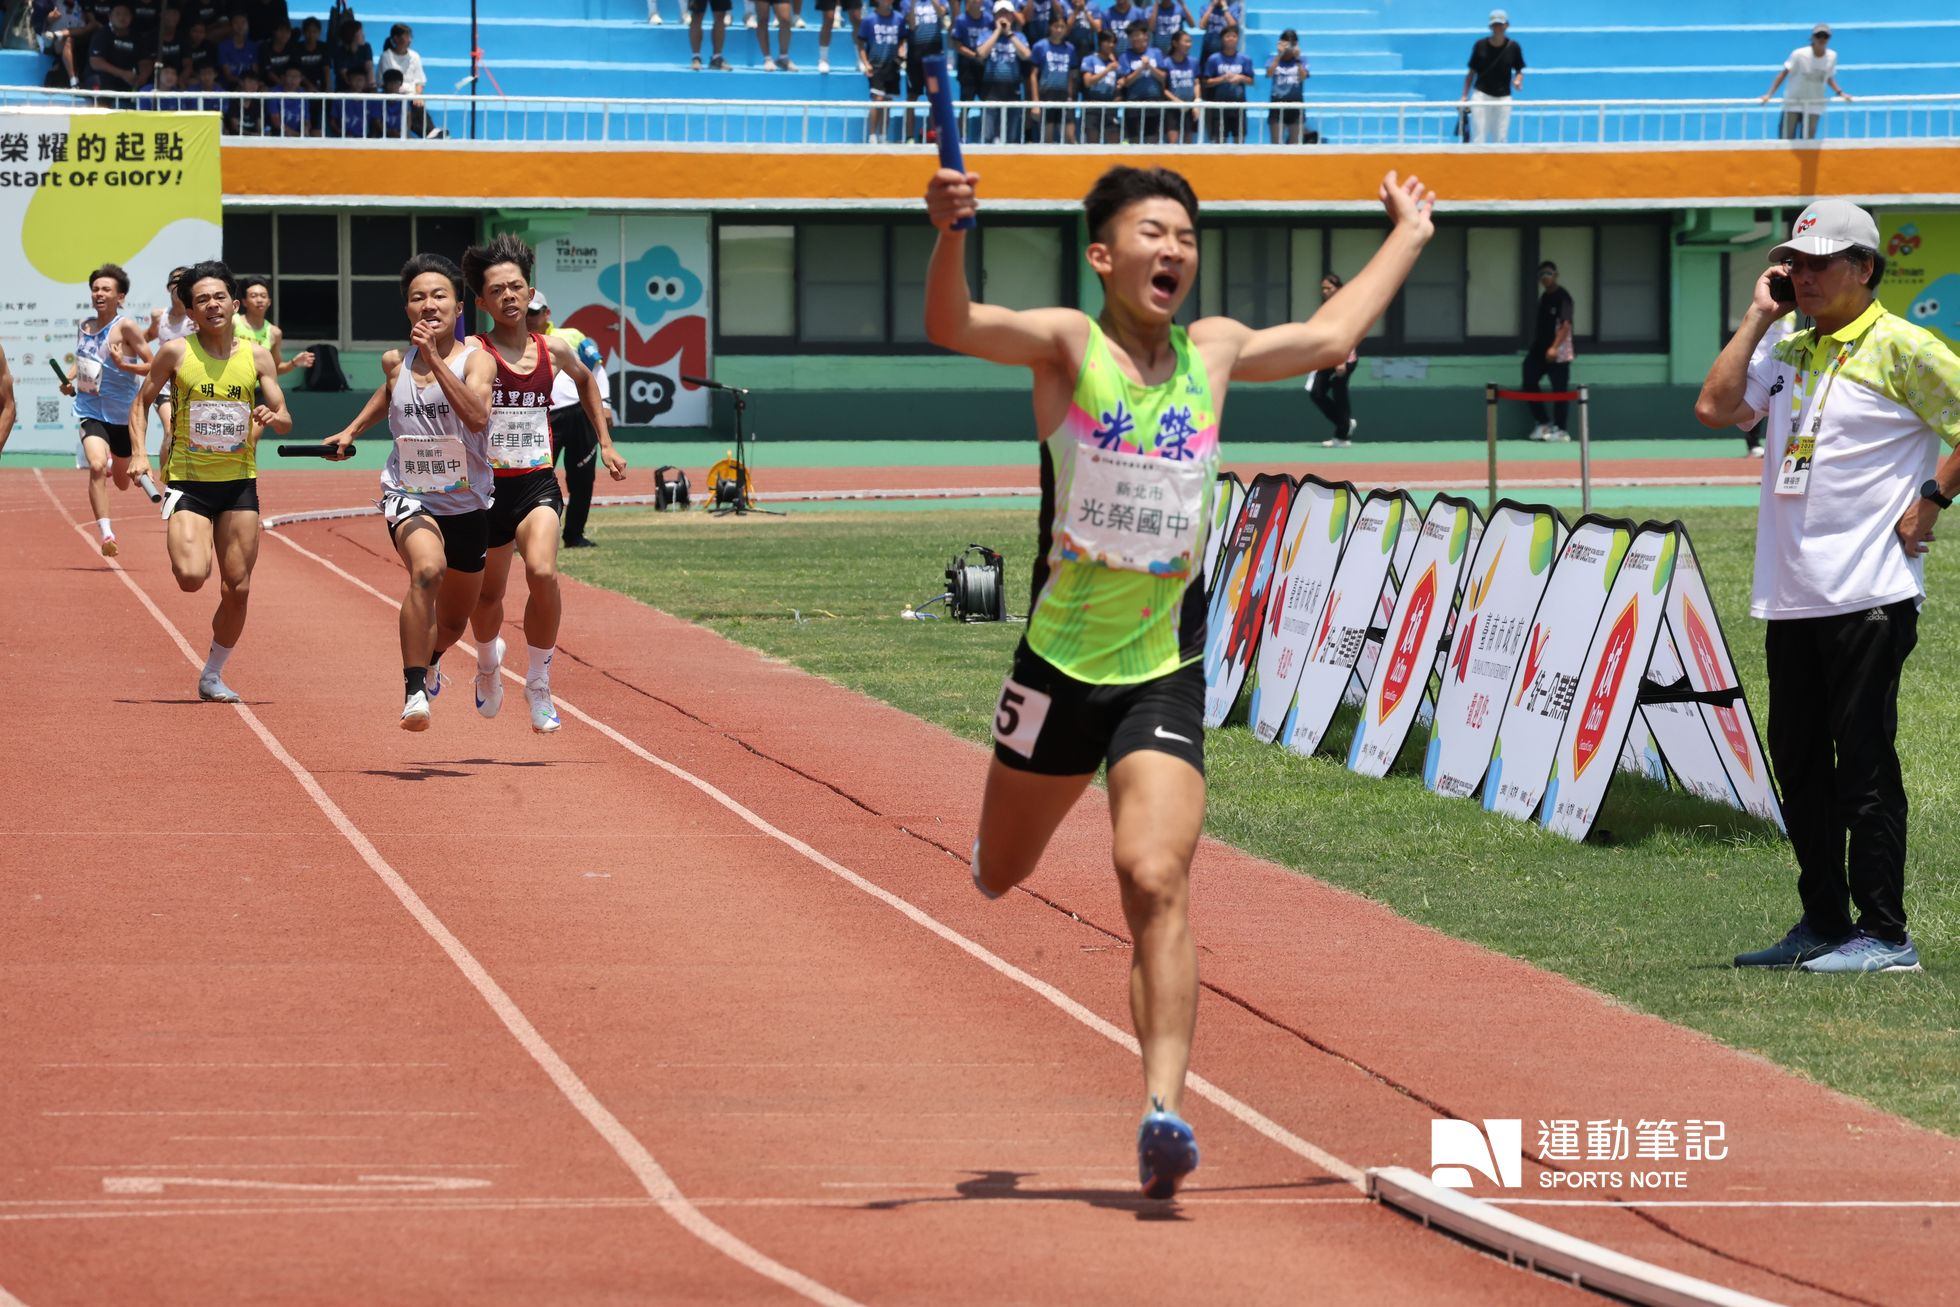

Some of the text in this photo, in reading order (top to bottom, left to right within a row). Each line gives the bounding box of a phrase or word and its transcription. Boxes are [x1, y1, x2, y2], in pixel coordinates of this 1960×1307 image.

[0, 132, 184, 162] 榮耀的起點
[201, 383, 241, 400] 明湖
[194, 422, 245, 436] 明湖國中
[1092, 400, 1198, 461] 光榮
[490, 432, 545, 448] 佳里國中
[404, 459, 461, 475] 東興國中
[1115, 481, 1164, 501] 新北市
[1078, 498, 1189, 538] 光榮國中
[996, 686, 1025, 736] 5
